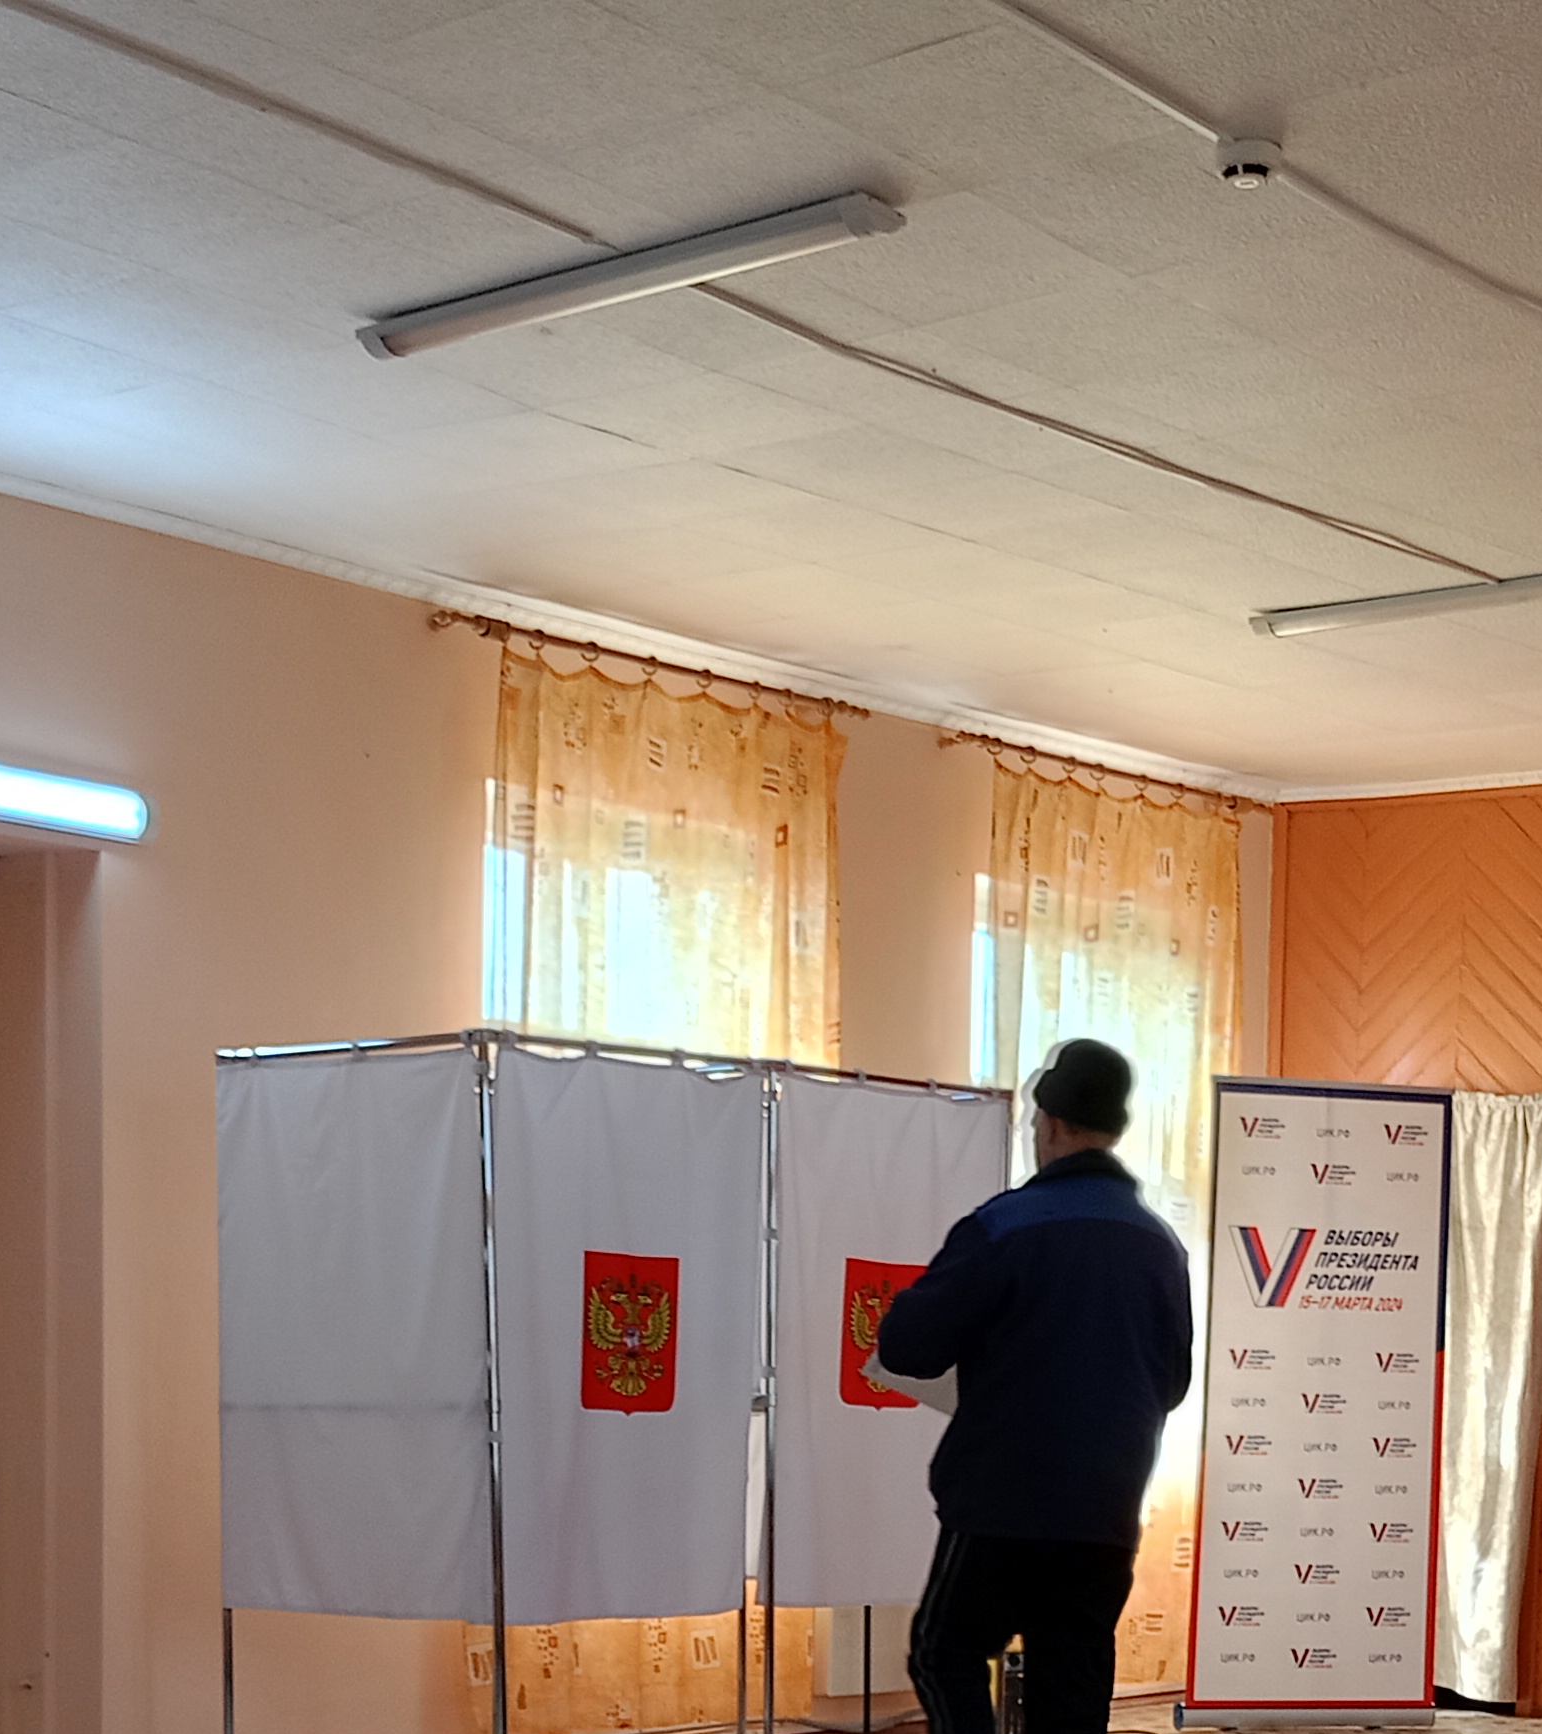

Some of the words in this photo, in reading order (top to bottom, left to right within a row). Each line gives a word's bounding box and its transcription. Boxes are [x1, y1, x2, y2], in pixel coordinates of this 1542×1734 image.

[1324, 1230, 1399, 1247] ВЫБОРЫ
[1315, 1252, 1419, 1271] ПРЕЗИДЕНТА
[1306, 1274, 1374, 1291] РОССИИ
[1332, 1297, 1373, 1310] МАРТА
[1374, 1296, 1403, 1312] 2024
